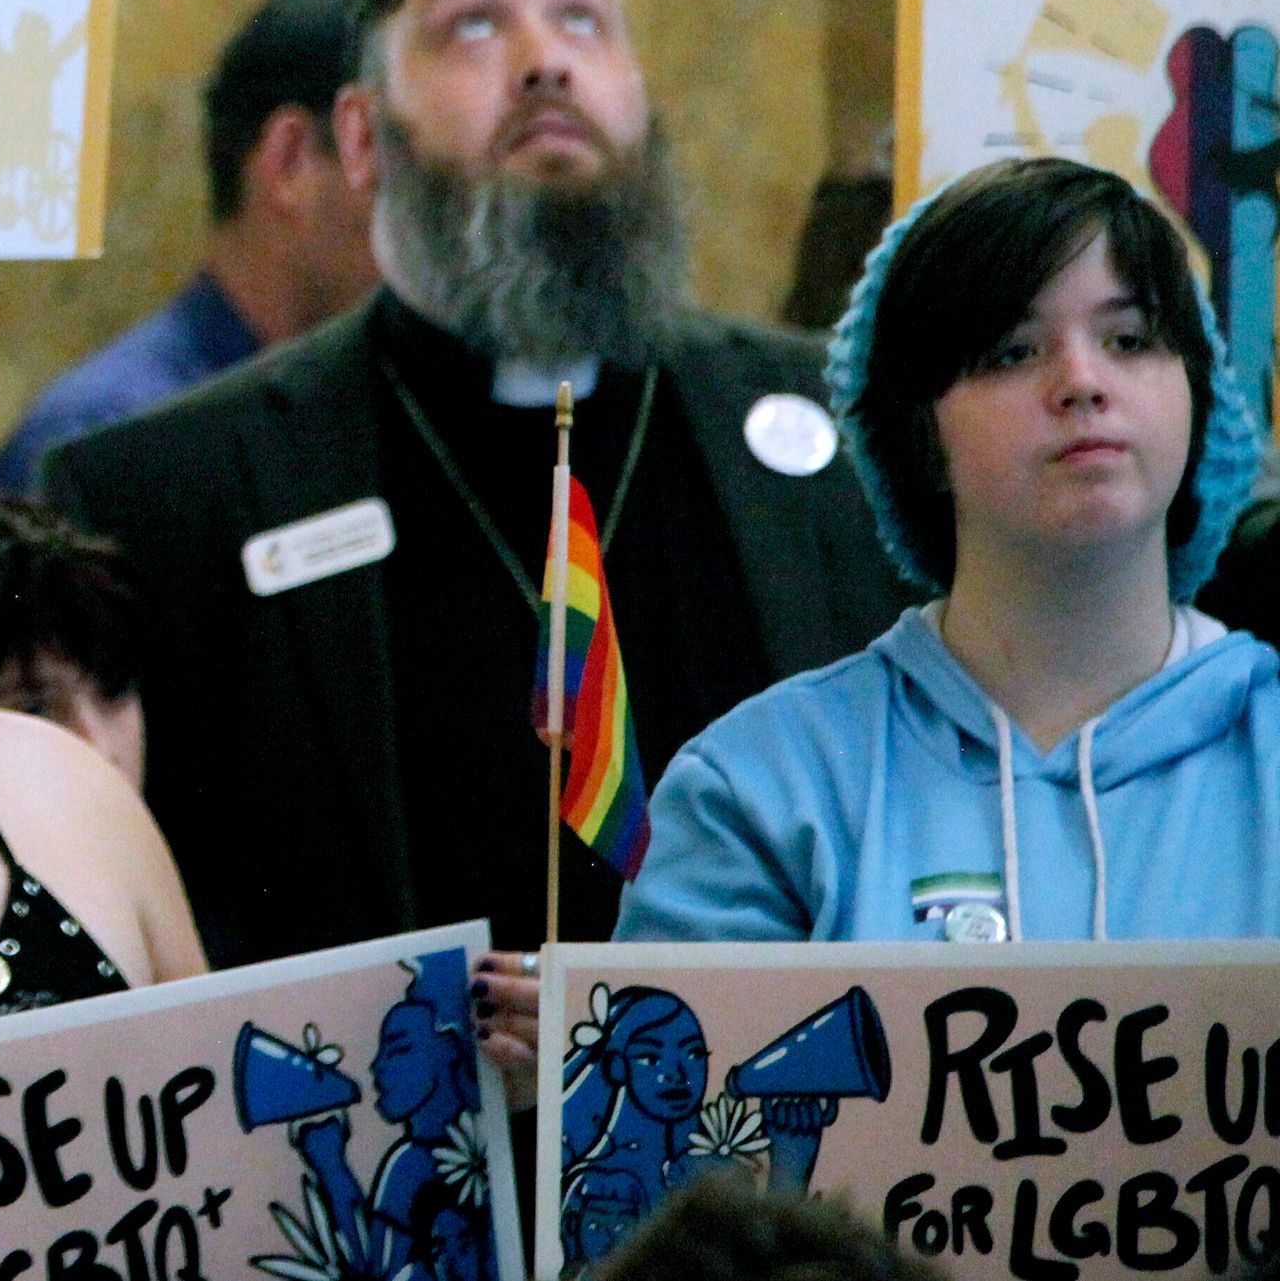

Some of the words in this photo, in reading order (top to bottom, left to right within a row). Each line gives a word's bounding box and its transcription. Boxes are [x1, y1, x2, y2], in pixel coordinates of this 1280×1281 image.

[105, 1066, 216, 1191] UP
[920, 985, 1183, 1161] RISE
[1204, 1022, 1280, 1146] U
[883, 1172, 994, 1256] FOR
